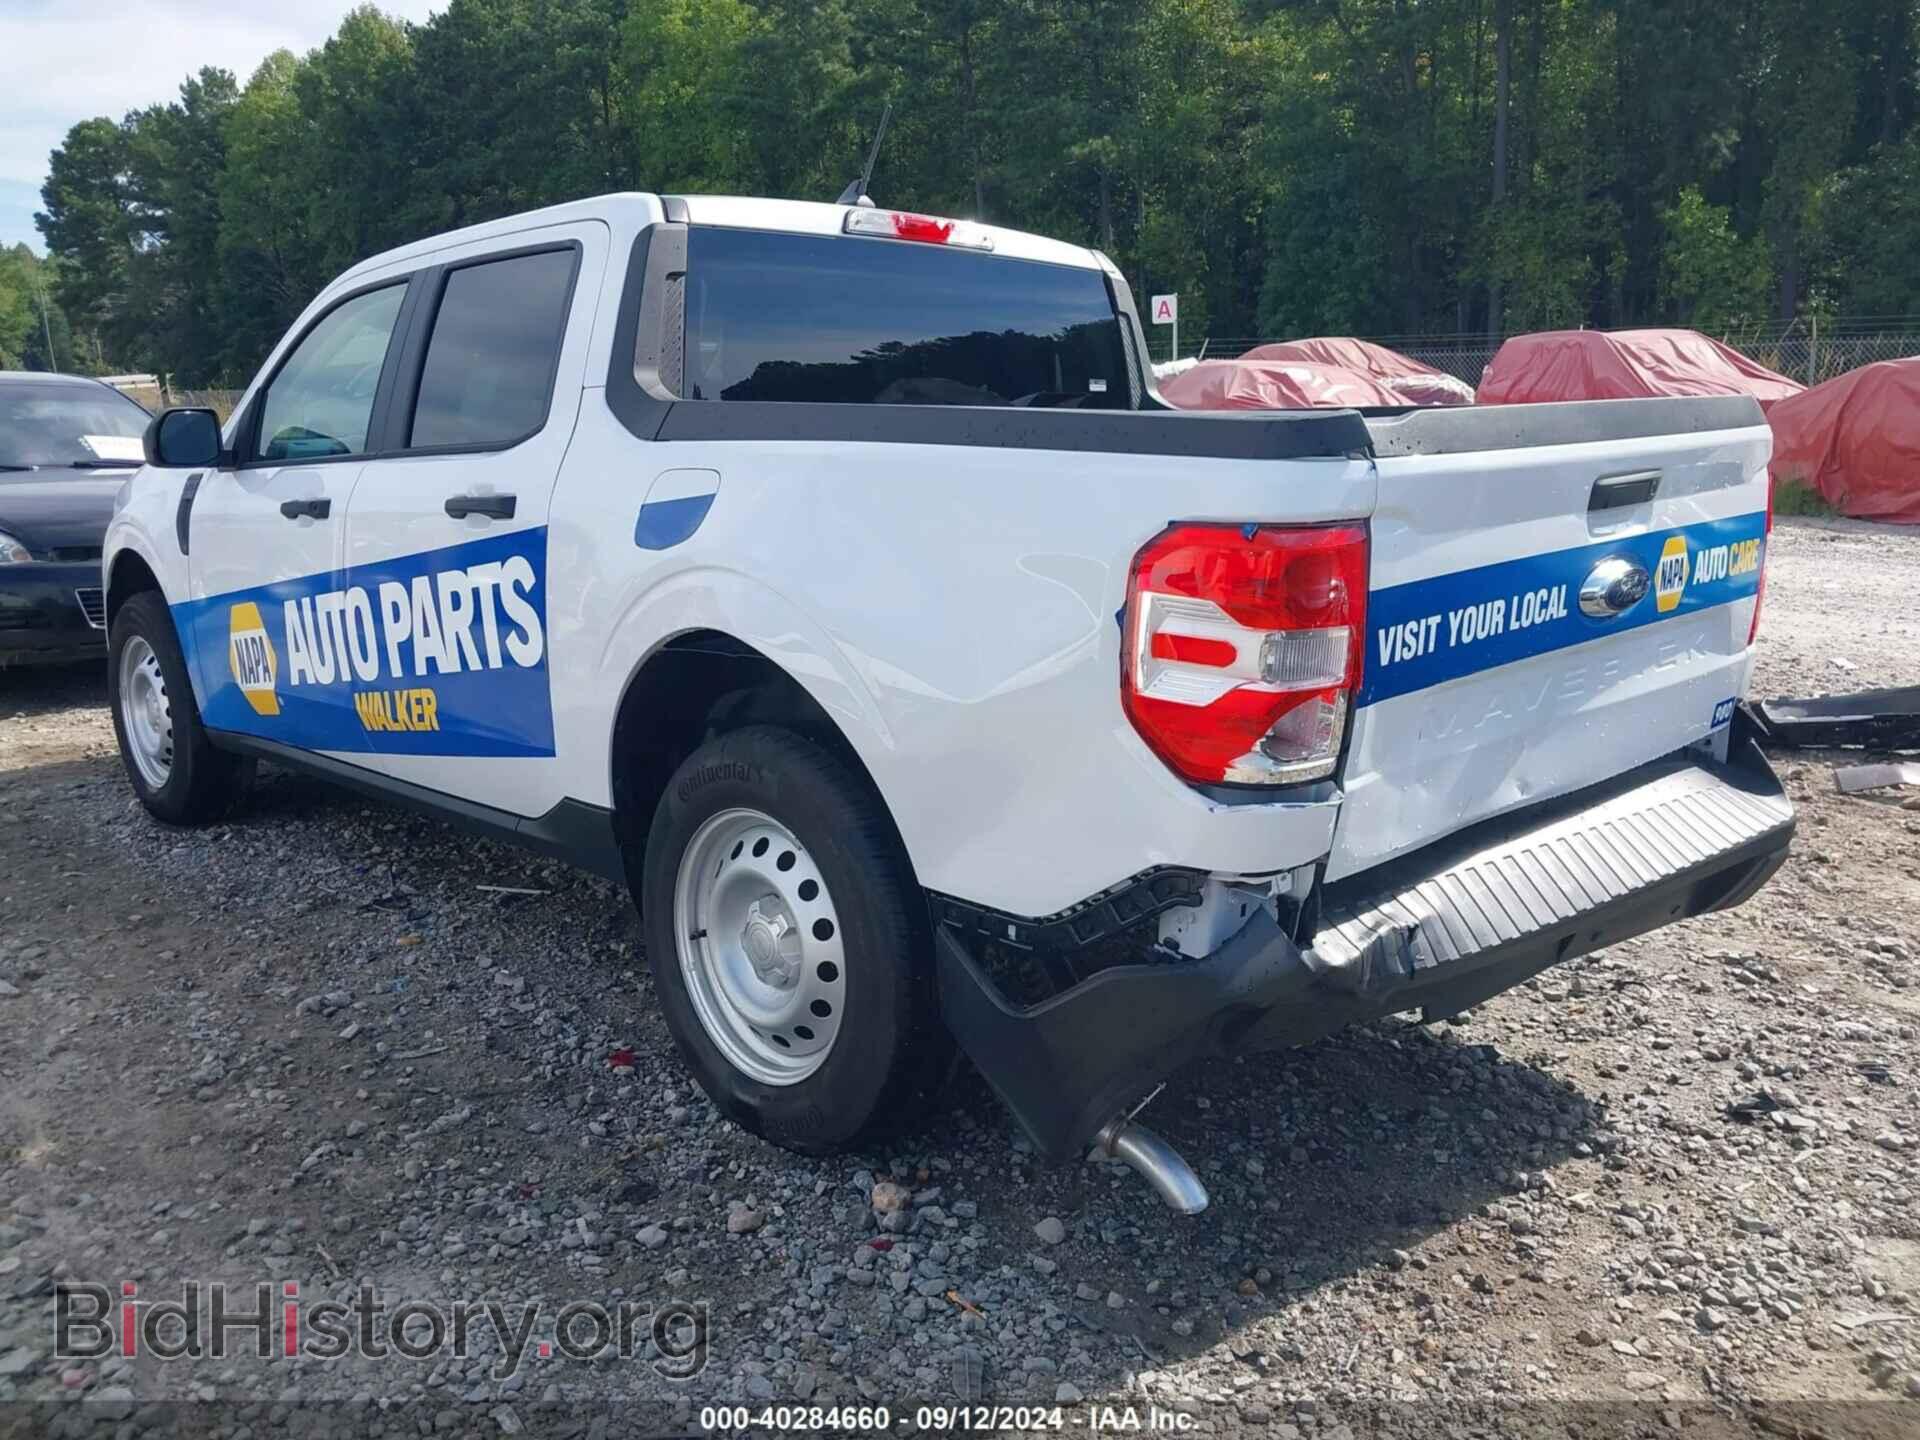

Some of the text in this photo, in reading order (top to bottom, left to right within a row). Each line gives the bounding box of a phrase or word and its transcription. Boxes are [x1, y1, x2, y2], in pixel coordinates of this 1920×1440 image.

[1157, 300, 1172, 319] A
[1661, 557, 1685, 593] NAPA
[1693, 538, 1761, 585] AUTO CARE
[283, 555, 544, 686] AUTO PARTS
[1377, 583, 1568, 668] VISIT YOUR LOCAL
[235, 634, 272, 686] NAPA
[354, 687, 441, 732] WALKER
[677, 761, 752, 802] Continental
